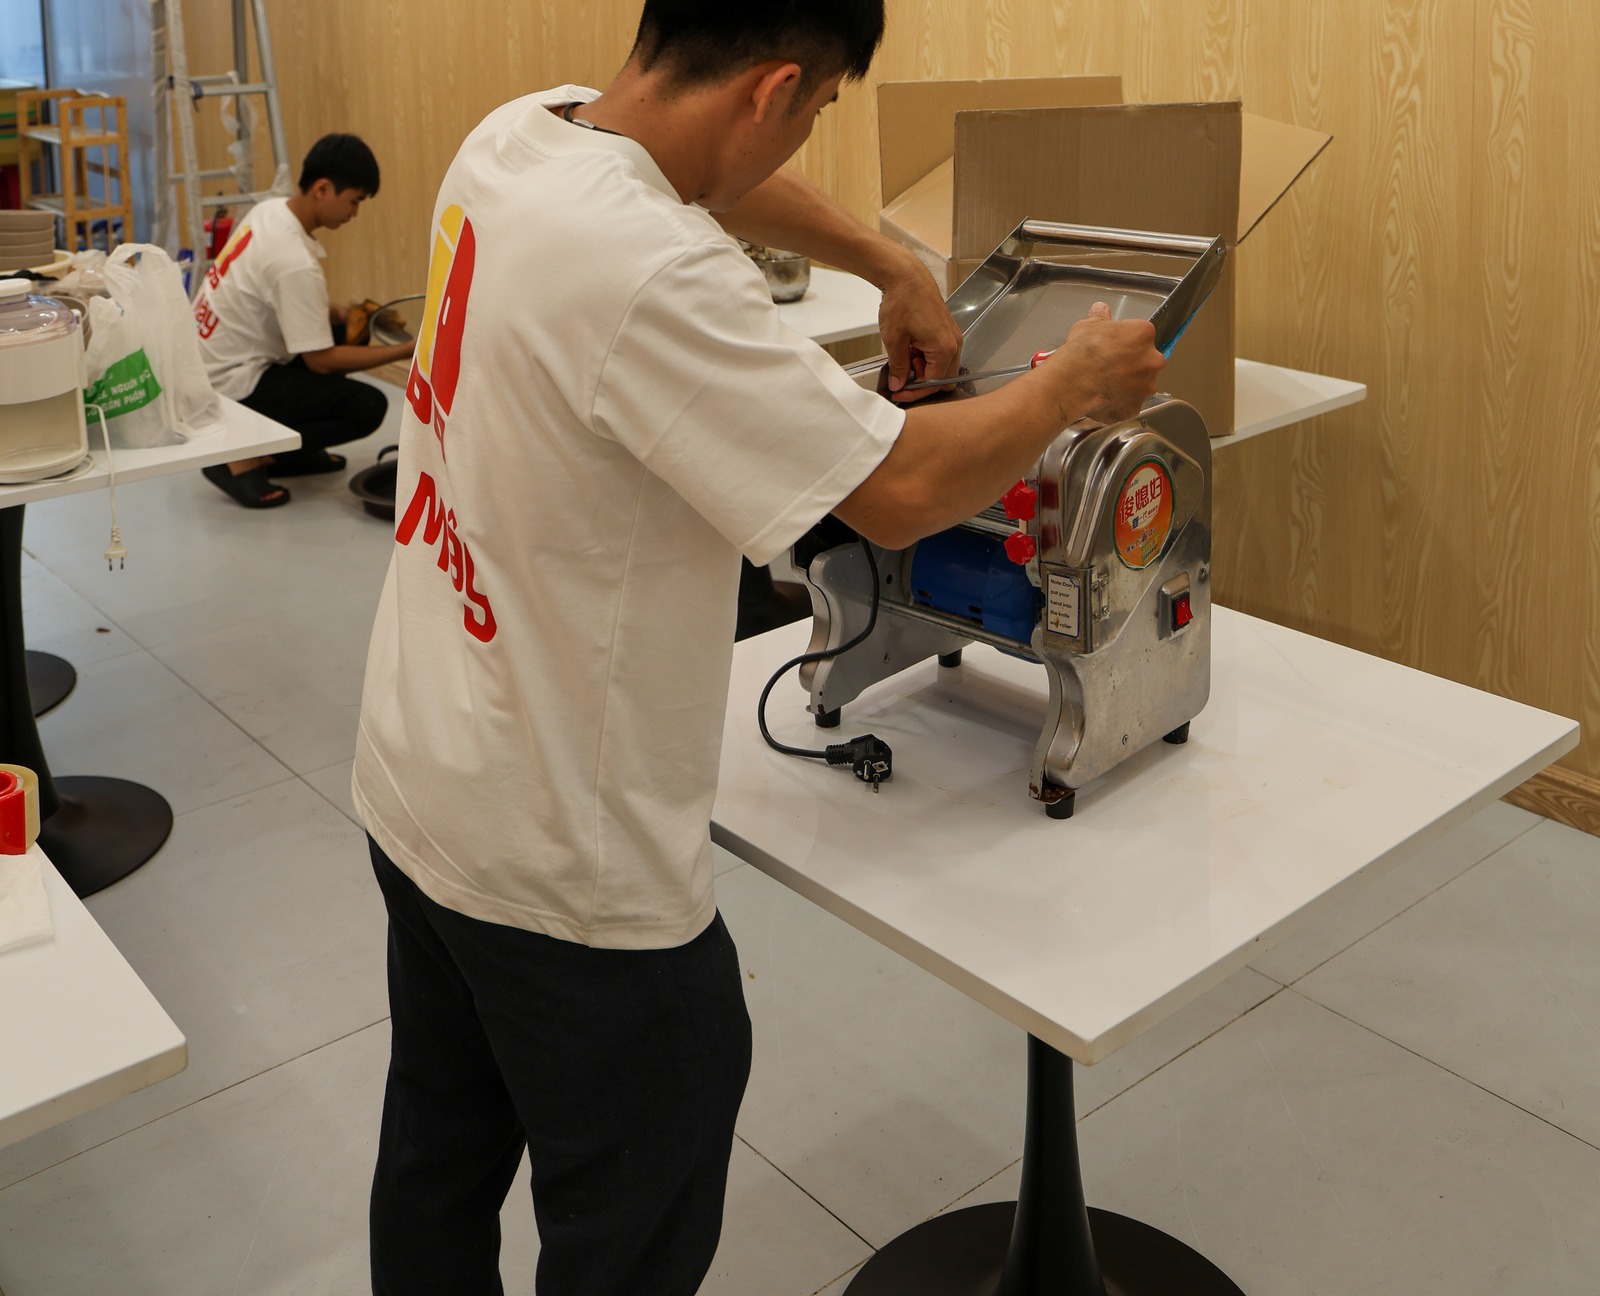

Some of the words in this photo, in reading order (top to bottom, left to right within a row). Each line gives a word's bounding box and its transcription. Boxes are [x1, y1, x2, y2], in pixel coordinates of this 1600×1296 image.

[1120, 473, 1163, 525] 俊媳妇
[395, 471, 497, 644] Mây
[1050, 599, 1062, 607] hand
[1059, 622, 1072, 630] roller
